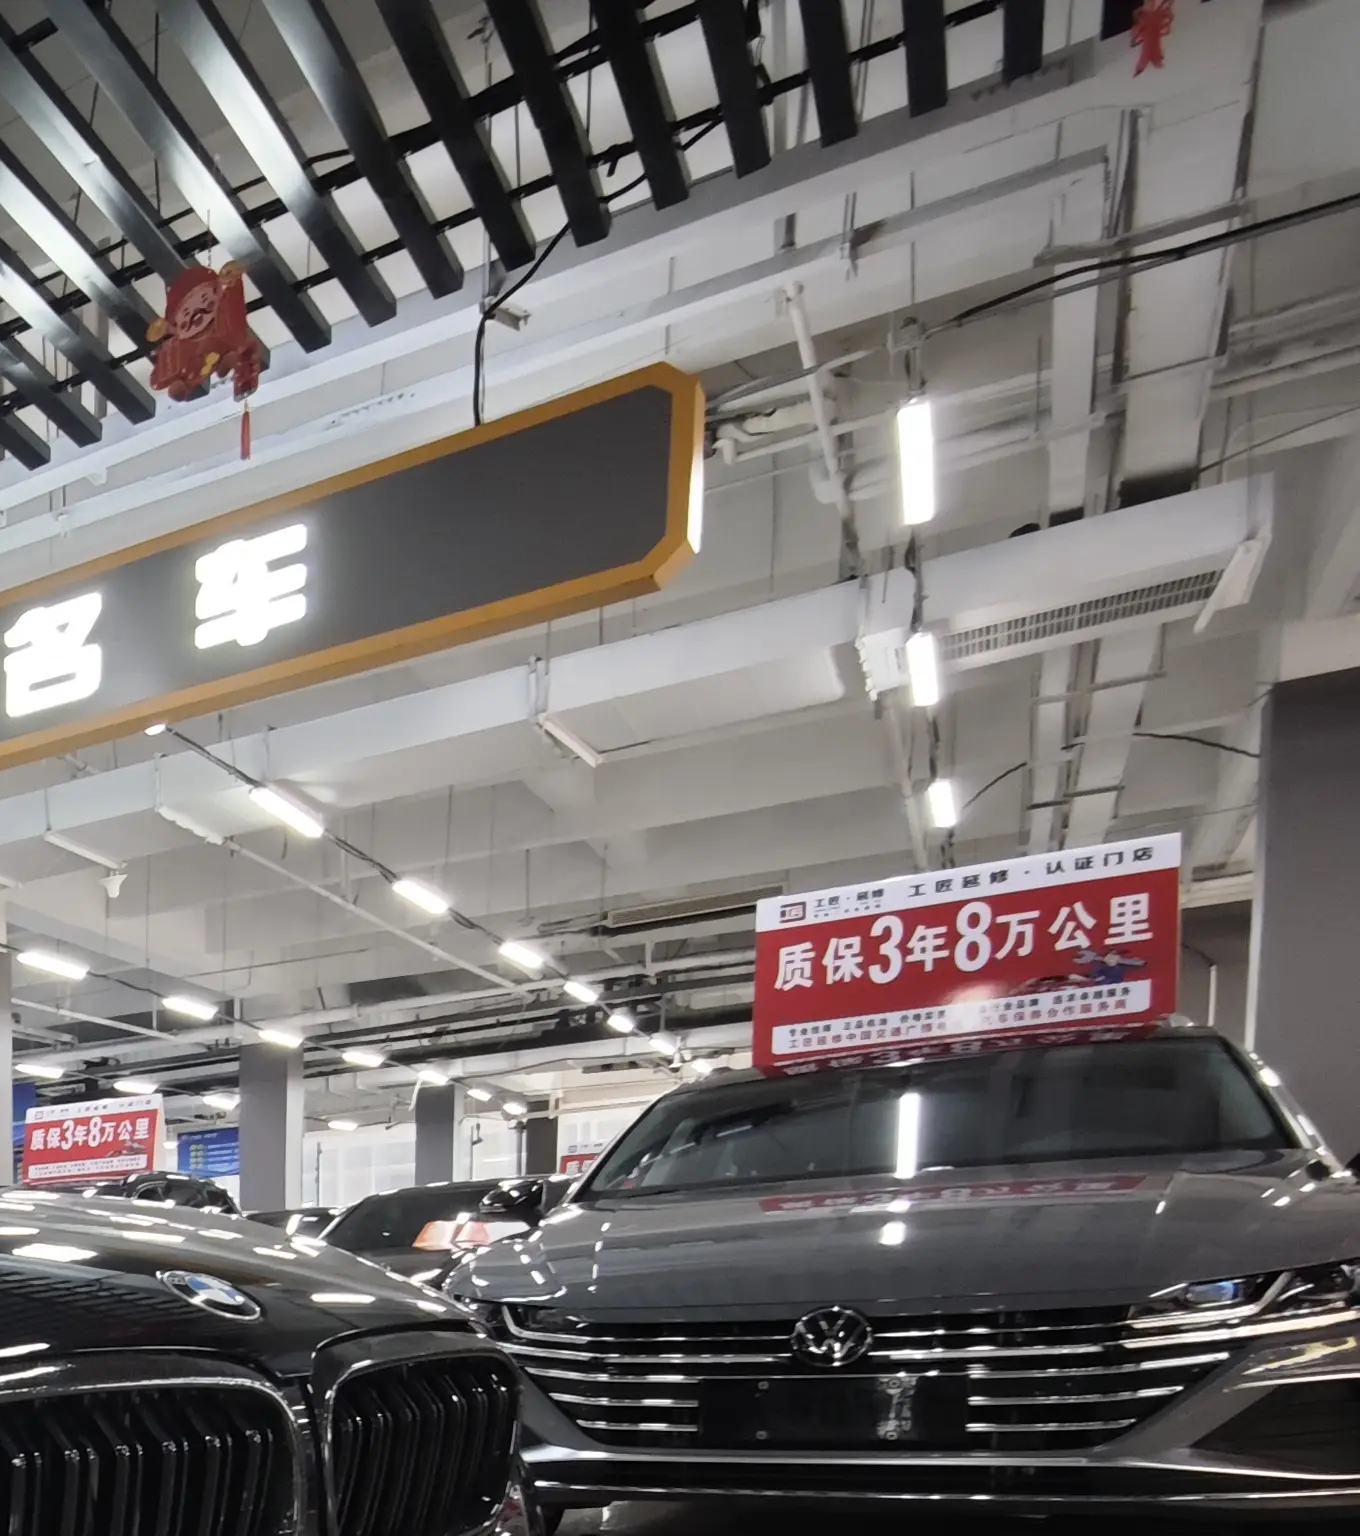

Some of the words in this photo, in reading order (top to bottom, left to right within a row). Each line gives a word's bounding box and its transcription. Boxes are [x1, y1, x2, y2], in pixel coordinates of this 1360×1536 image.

[774, 893, 1154, 991] 质保3年8万公里
[30, 1116, 151, 1151] 质保3年8万公里
